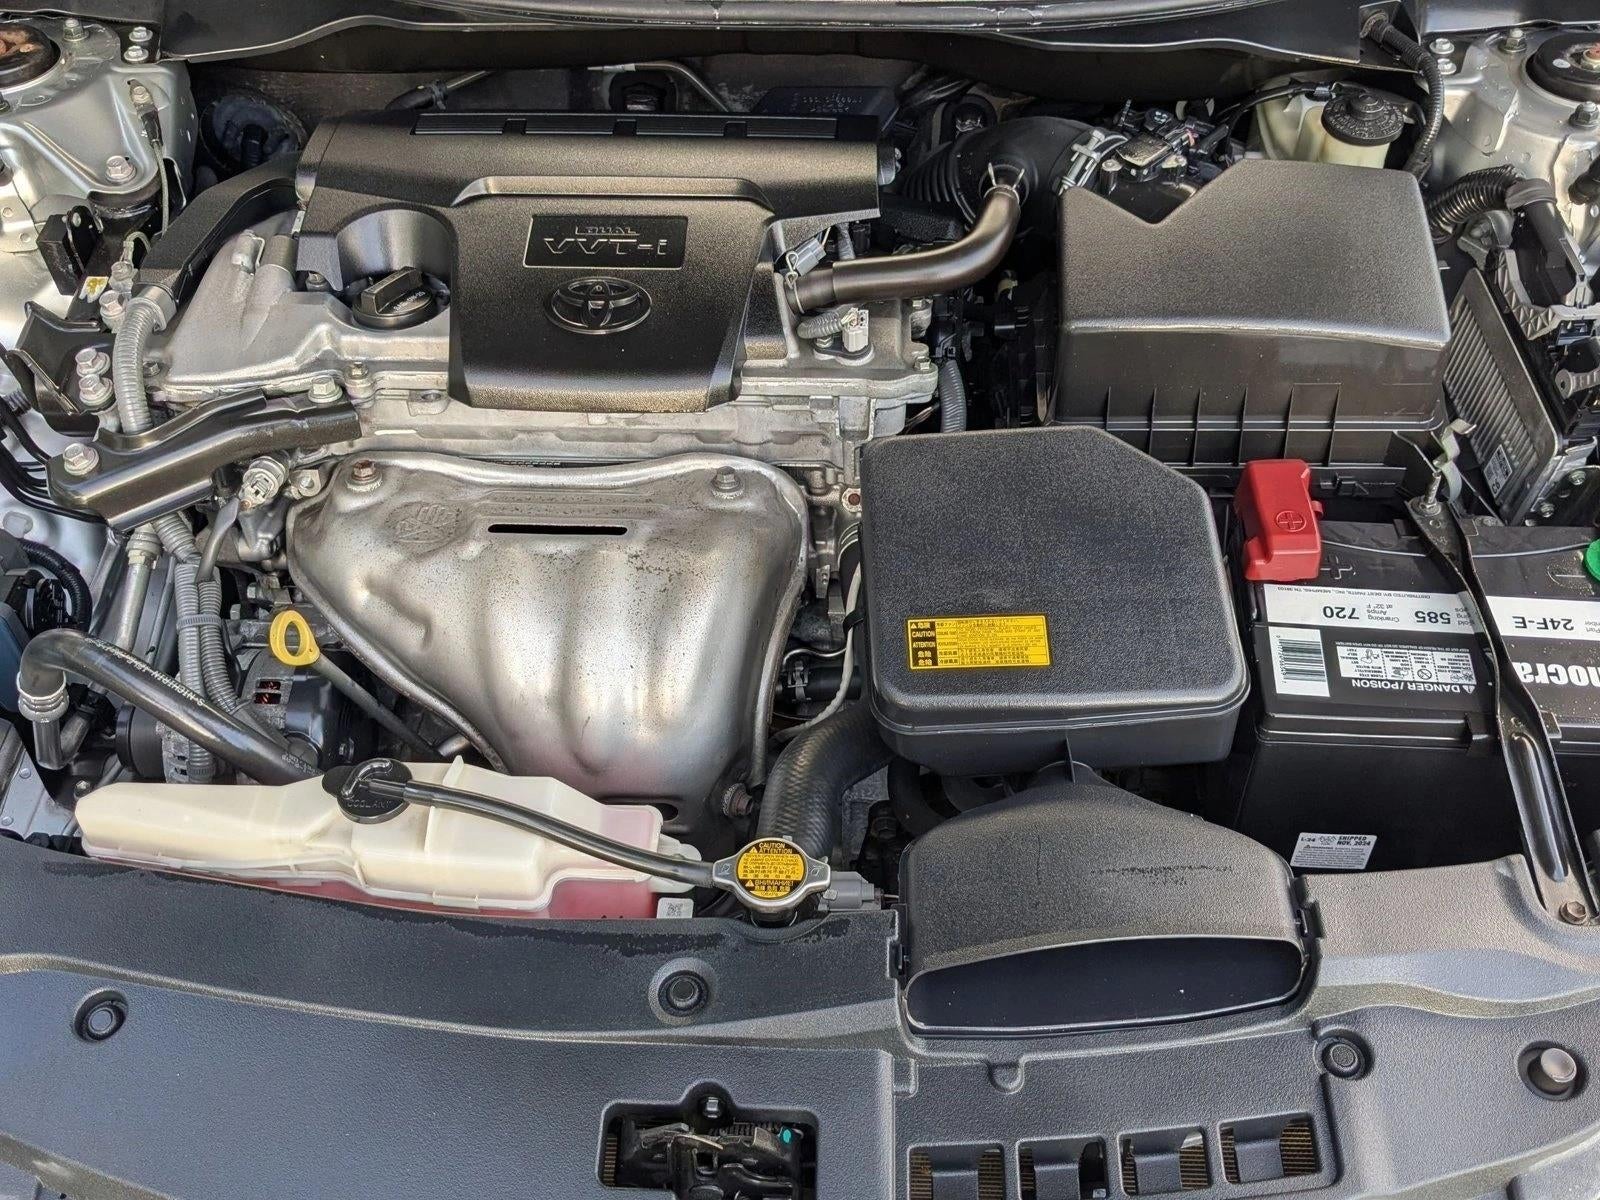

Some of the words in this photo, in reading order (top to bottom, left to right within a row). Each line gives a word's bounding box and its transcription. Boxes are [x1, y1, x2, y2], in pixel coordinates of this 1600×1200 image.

[1322, 606, 1360, 620] 720
[1367, 614, 1399, 623] Cranking
[1414, 610, 1451, 625] 585
[1512, 616, 1574, 631] 24F-E
[911, 630, 936, 638] CAUTION
[1511, 662, 1600, 687] nocra
[1407, 682, 1461, 693] DANGER
